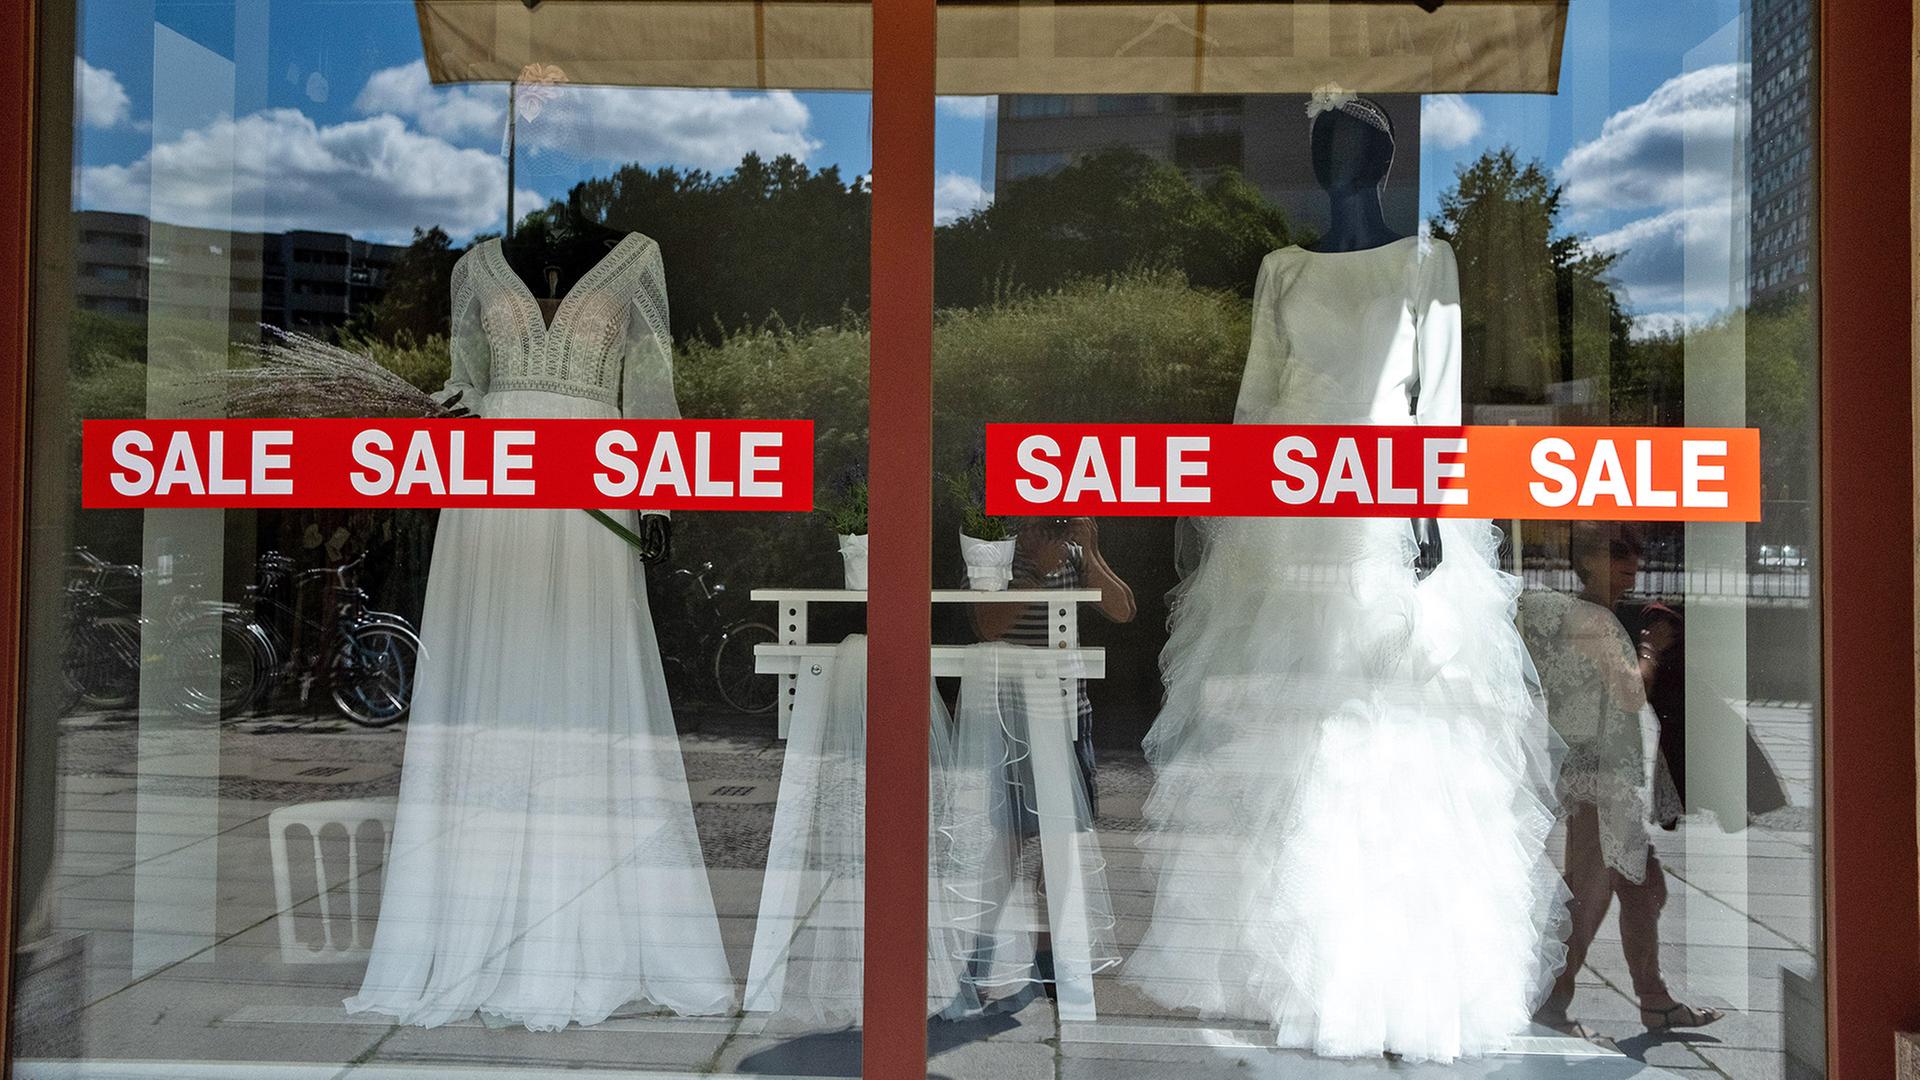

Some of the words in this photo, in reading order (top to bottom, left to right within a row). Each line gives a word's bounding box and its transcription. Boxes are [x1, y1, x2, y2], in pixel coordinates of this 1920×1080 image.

[110, 430, 294, 497] SALE
[350, 429, 536, 497] SALE
[593, 429, 783, 498] SALE
[1015, 434, 1211, 504] SALE
[1271, 435, 1469, 505] SALE
[1529, 437, 1729, 509] SALE
